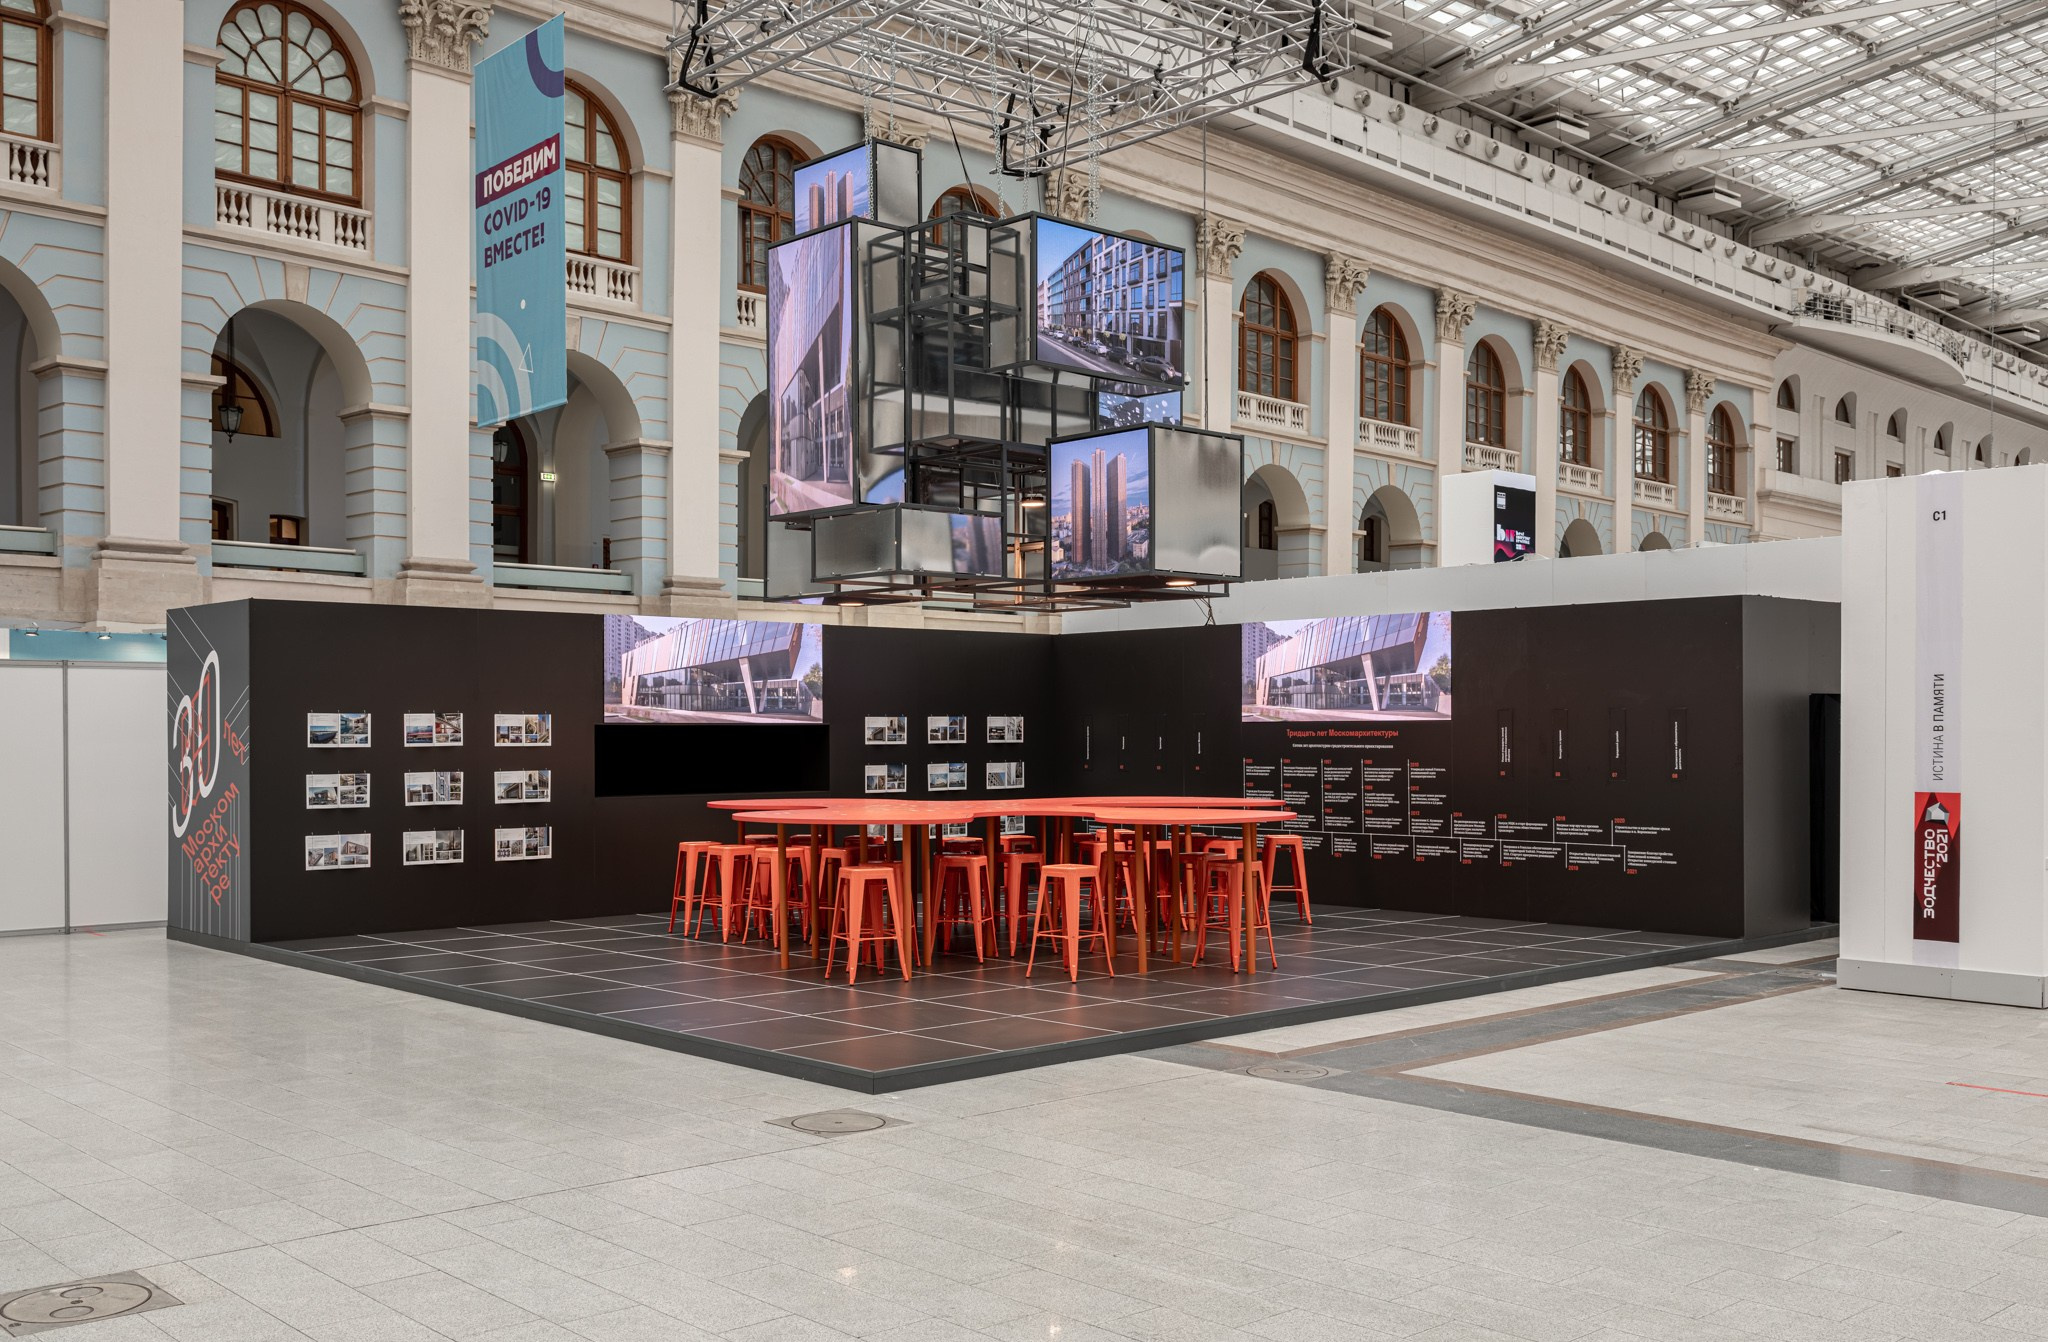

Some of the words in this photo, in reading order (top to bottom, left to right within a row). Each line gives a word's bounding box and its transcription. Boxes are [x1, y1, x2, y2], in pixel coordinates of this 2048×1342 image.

[483, 142, 556, 198] ПОБЕДИМ
[484, 186, 551, 236] COVID-19
[484, 223, 546, 269] ВМЕСТЕ!
[1933, 673, 1944, 722] ПАМЯТИ
[172, 650, 220, 838] 30
[223, 719, 246, 765] лет
[1287, 729, 1316, 738] Тридцать
[1328, 729, 1399, 738] Москомархитектуры
[1933, 734, 1944, 781] ИСТИНА
[182, 782, 240, 860] Моском
[193, 824, 228, 874] архи
[200, 832, 240, 886] текту
[1923, 828, 1936, 919] ЗОДЧЕСТВО
[210, 873, 231, 907] ре
